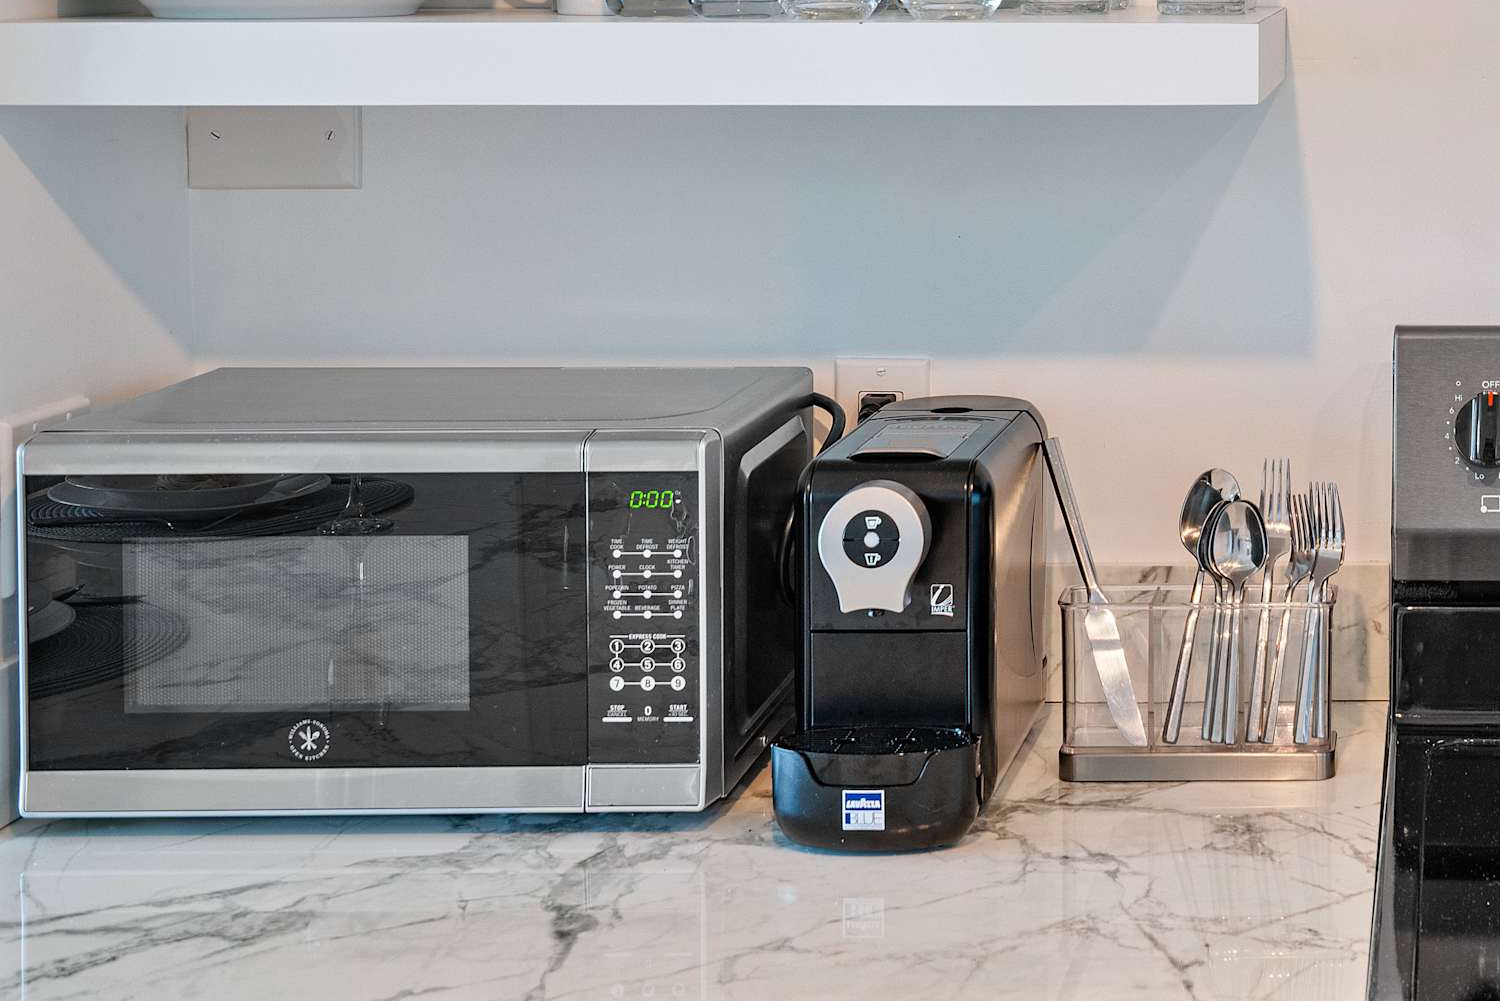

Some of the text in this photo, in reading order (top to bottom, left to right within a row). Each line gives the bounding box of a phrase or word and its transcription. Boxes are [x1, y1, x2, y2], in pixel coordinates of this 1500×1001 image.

[1482, 380, 1500, 389] OFF
[1475, 472, 1485, 480] Lo
[629, 490, 674, 509] 0:00
[644, 641, 652, 651] 2
[674, 641, 682, 651] 3
[612, 660, 621, 670] 4
[644, 660, 652, 670] 5
[674, 660, 682, 670] 6
[644, 705, 652, 716] 0
